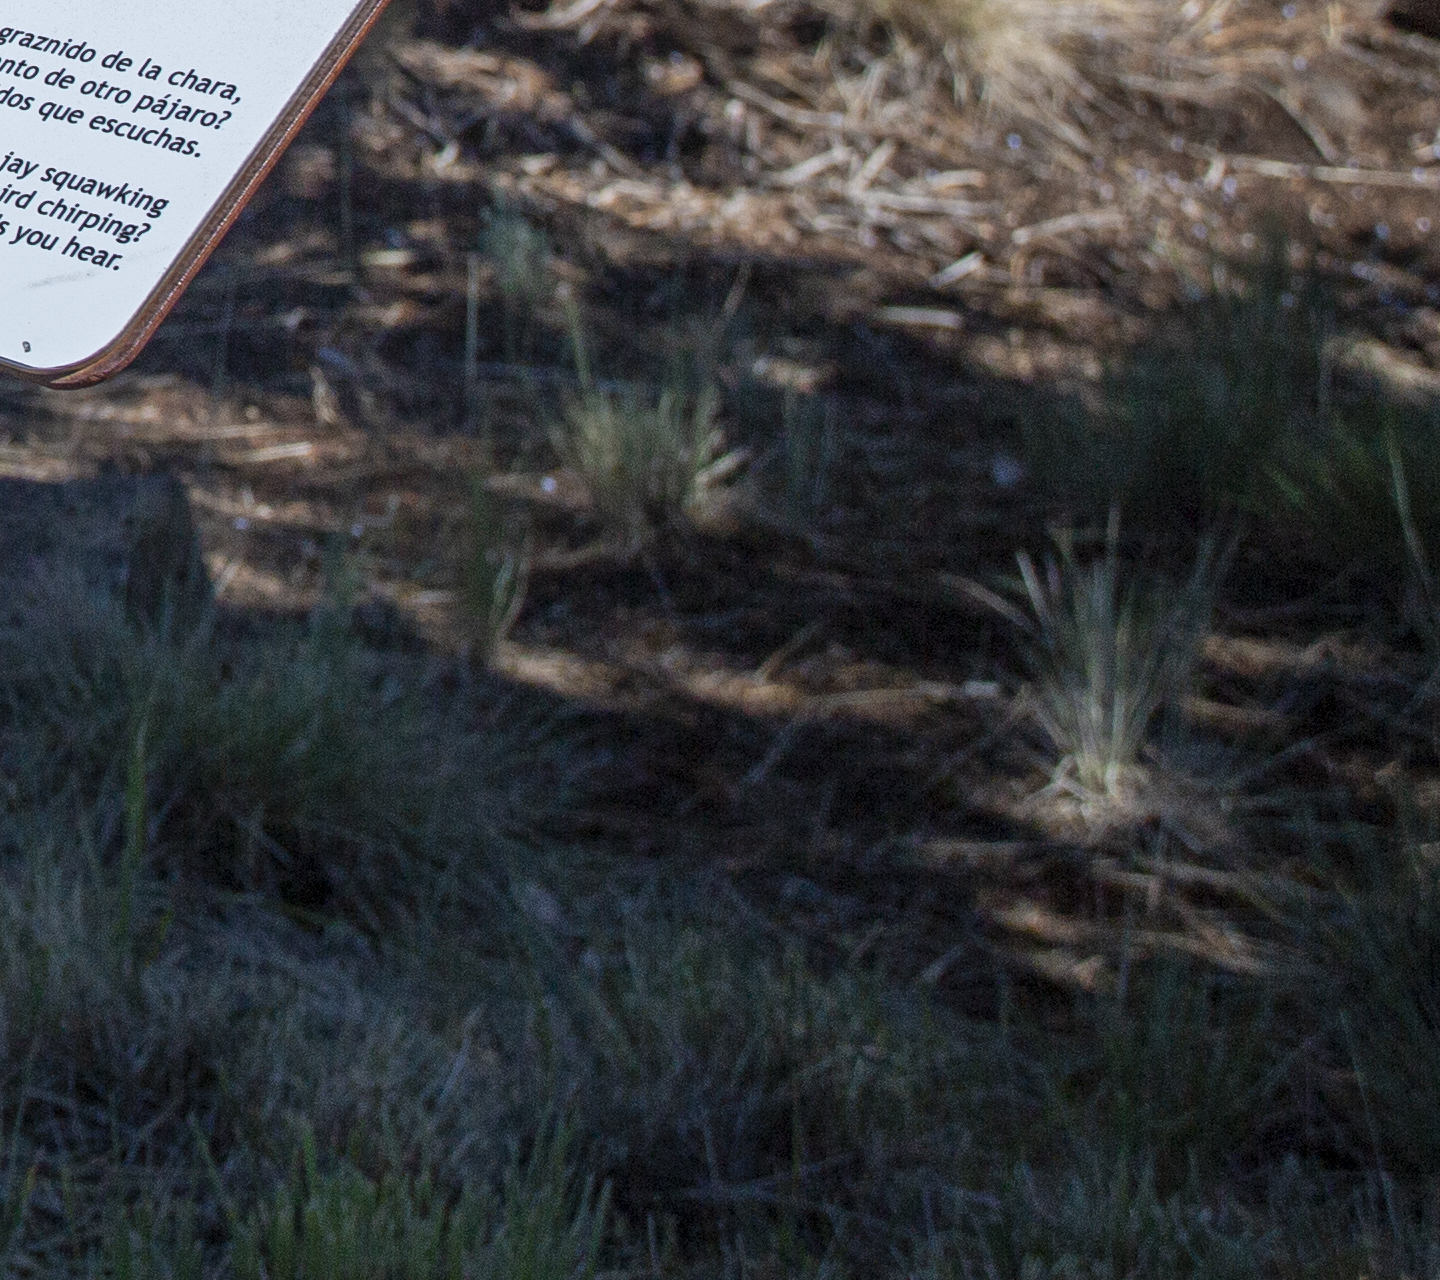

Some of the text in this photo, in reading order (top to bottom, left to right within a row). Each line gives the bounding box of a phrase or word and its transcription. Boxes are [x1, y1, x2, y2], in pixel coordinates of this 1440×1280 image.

[43, 67, 76, 90] de
[79, 80, 132, 105] otro
[131, 93, 233, 130] pájaro?
[101, 50, 133, 73] de
[137, 57, 163, 81] la
[167, 68, 241, 106] chara,
[38, 101, 85, 125] que
[88, 115, 201, 158] escuchas.
[39, 167, 170, 219] squawking
[8, 225, 60, 251] you
[61, 235, 124, 271] hear.
[37, 197, 152, 245] chirping?
